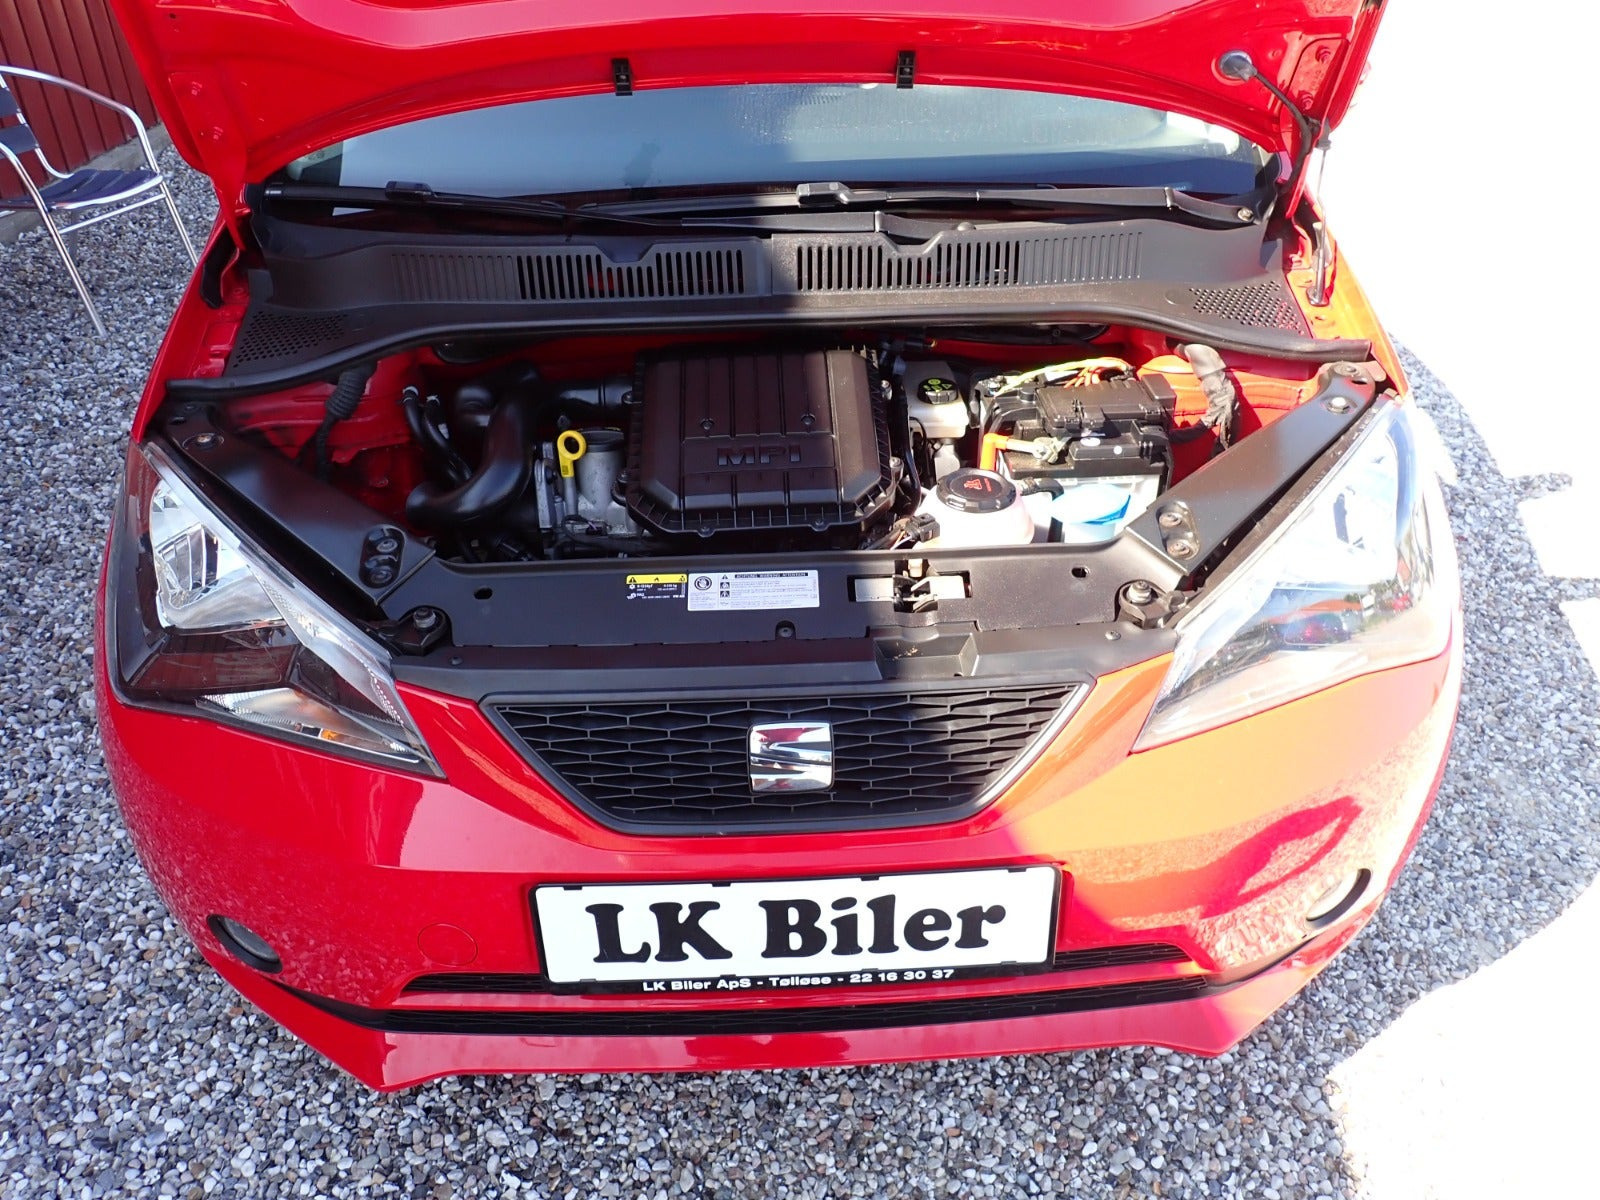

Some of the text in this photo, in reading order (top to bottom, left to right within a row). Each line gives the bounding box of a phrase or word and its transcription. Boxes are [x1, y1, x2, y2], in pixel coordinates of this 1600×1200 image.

[717, 444, 801, 466] MPI
[585, 894, 1006, 964] LK Biler
[642, 981, 667, 992] LK
[670, 980, 712, 991] Biler
[716, 977, 752, 991] ApS
[768, 975, 832, 987] Tølløse
[849, 972, 873, 984] 22
[877, 971, 898, 982] 16
[903, 970, 927, 981] 30
[931, 968, 955, 979] 37
